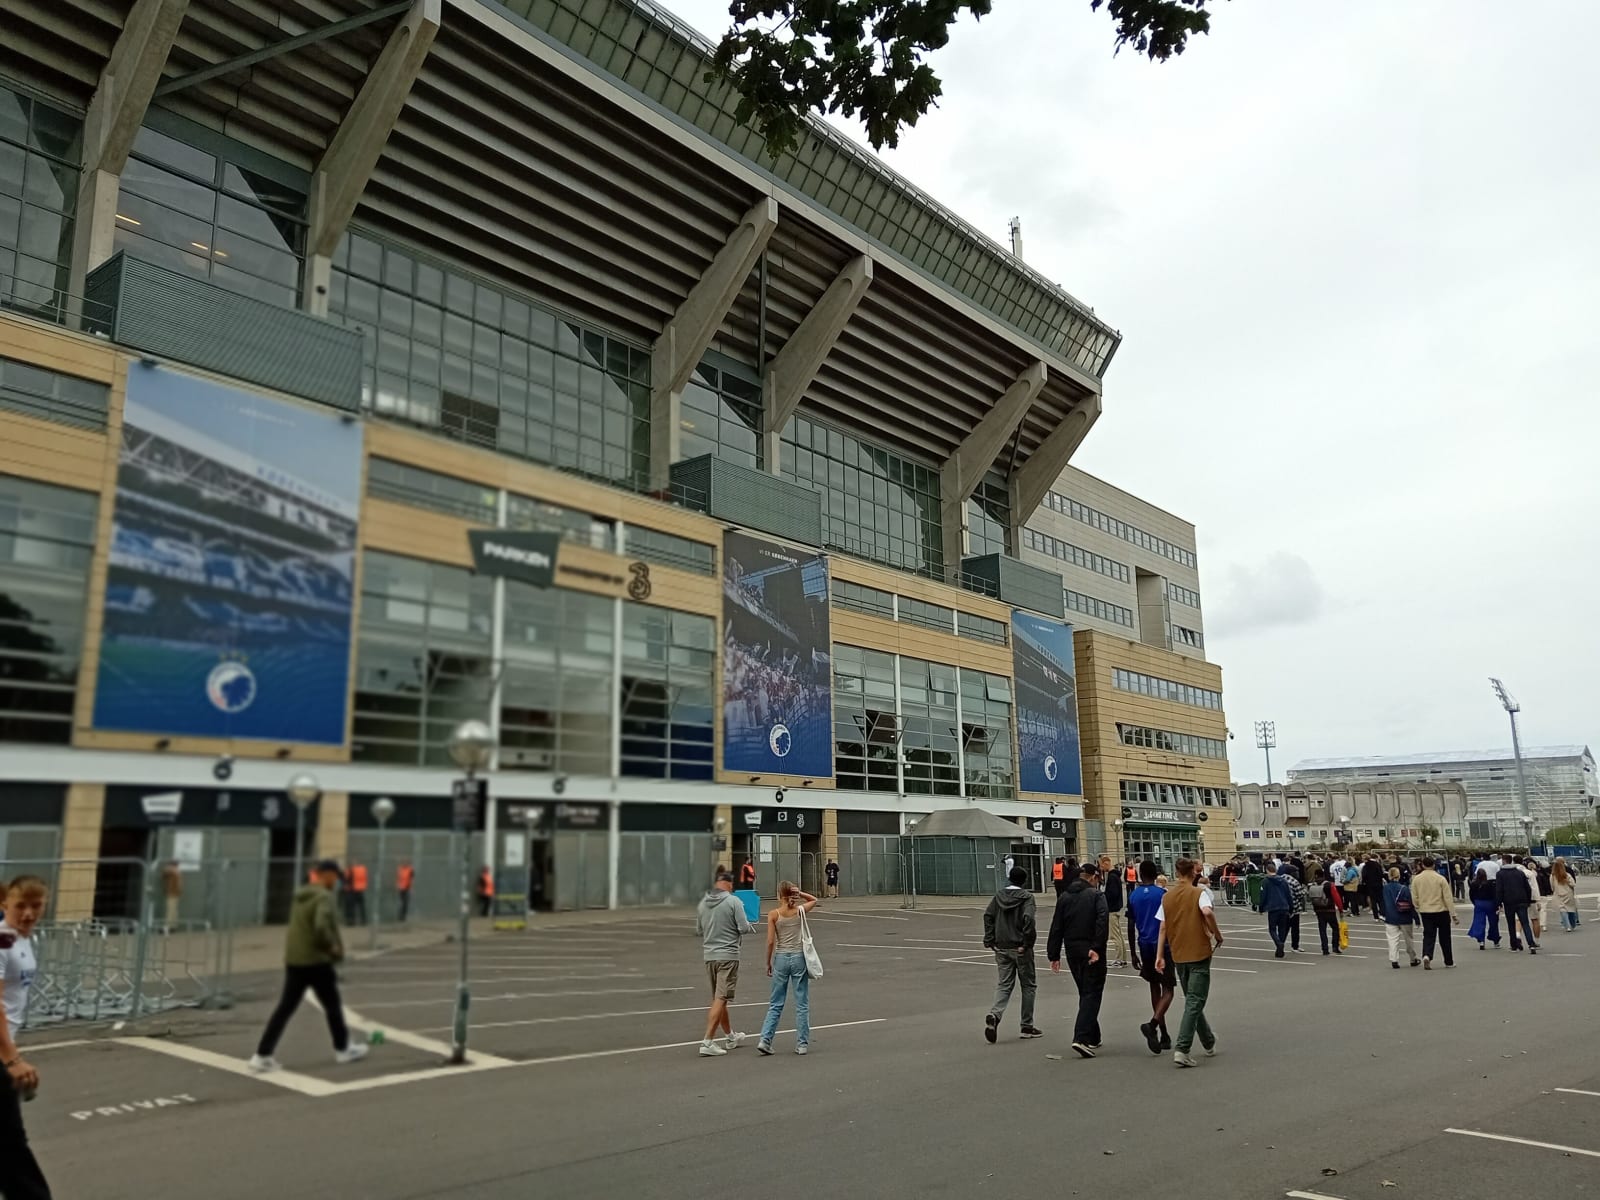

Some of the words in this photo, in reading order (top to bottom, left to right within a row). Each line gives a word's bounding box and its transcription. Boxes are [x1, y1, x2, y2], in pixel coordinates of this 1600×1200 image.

[483, 541, 550, 568] PARKEN
[627, 562, 651, 600] 3
[69, 1093, 196, 1120] PRIVAT
